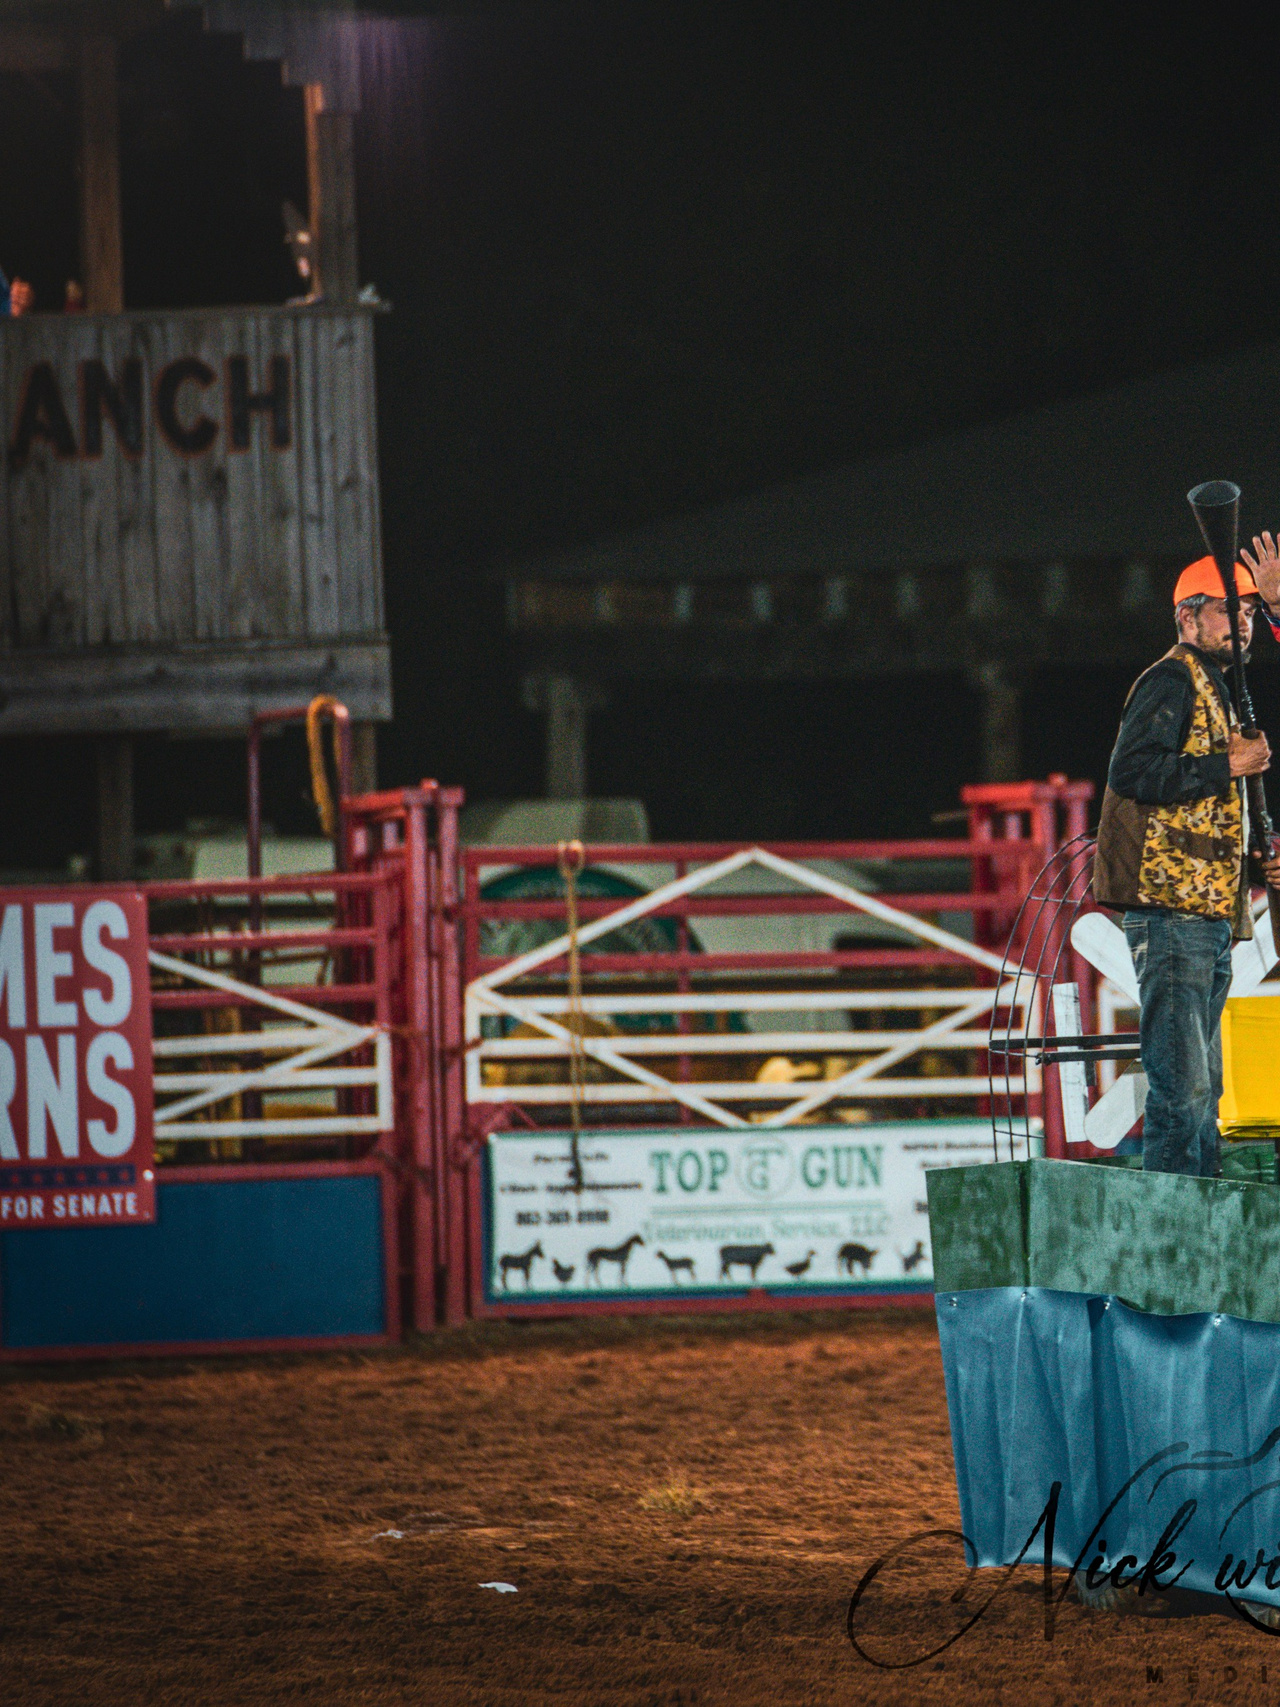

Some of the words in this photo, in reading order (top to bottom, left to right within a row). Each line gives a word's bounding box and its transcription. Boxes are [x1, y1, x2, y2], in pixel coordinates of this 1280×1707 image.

[8, 354, 292, 464] ANCH
[650, 1150, 730, 1194] TOP
[802, 1144, 884, 1189] GUN
[1, 1195, 45, 1219] FOR
[52, 1191, 138, 1218] SENATE
